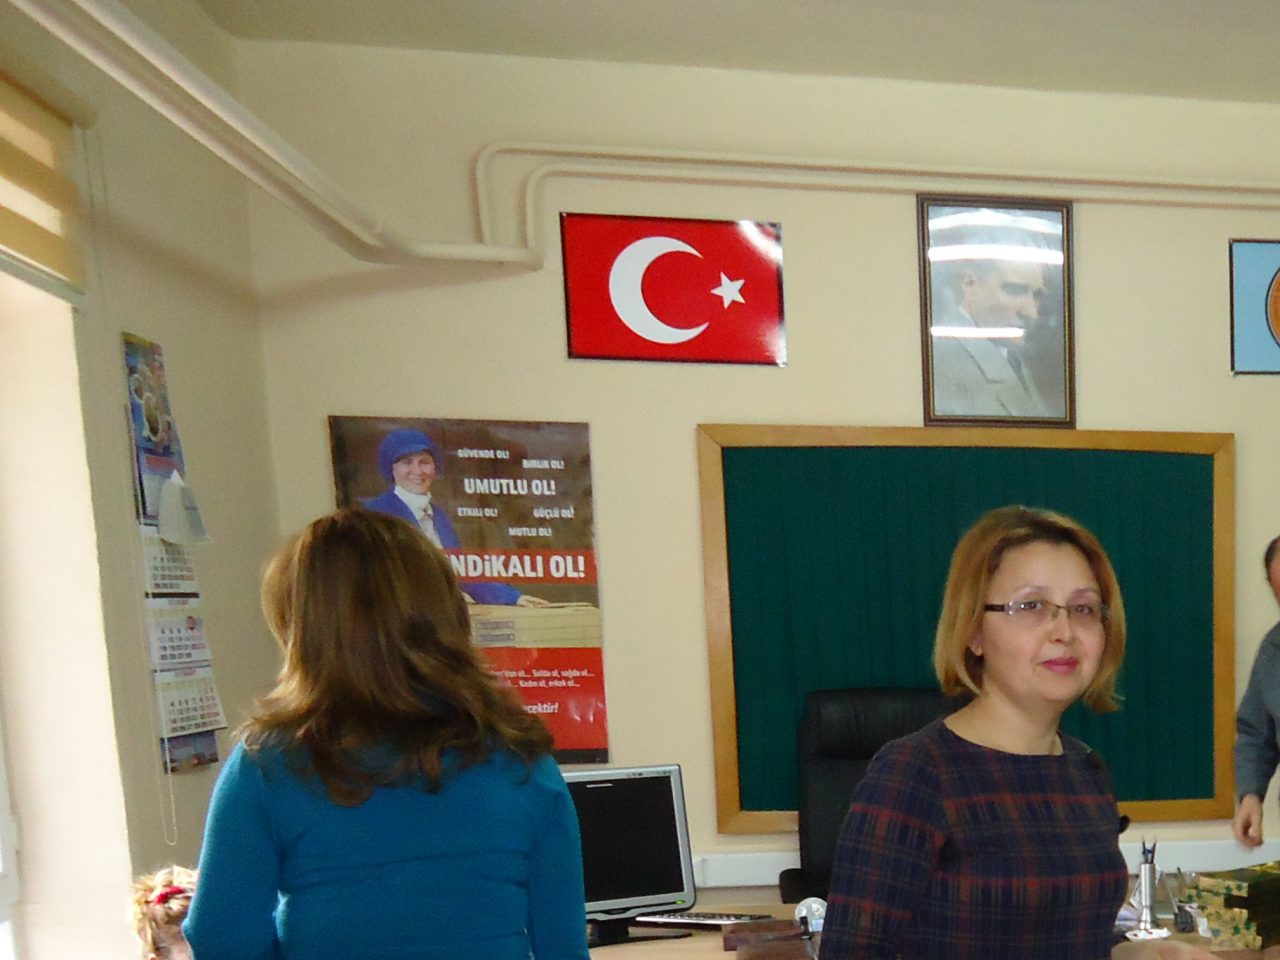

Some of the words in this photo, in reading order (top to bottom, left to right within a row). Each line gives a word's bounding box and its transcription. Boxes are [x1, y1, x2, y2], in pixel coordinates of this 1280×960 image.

[550, 460, 565, 469] OL!
[464, 478, 528, 494] UMUTLU
[531, 479, 556, 495] OL!
[484, 507, 498, 517] OL!
[538, 527, 552, 536] OL!
[551, 555, 586, 578] OL!
